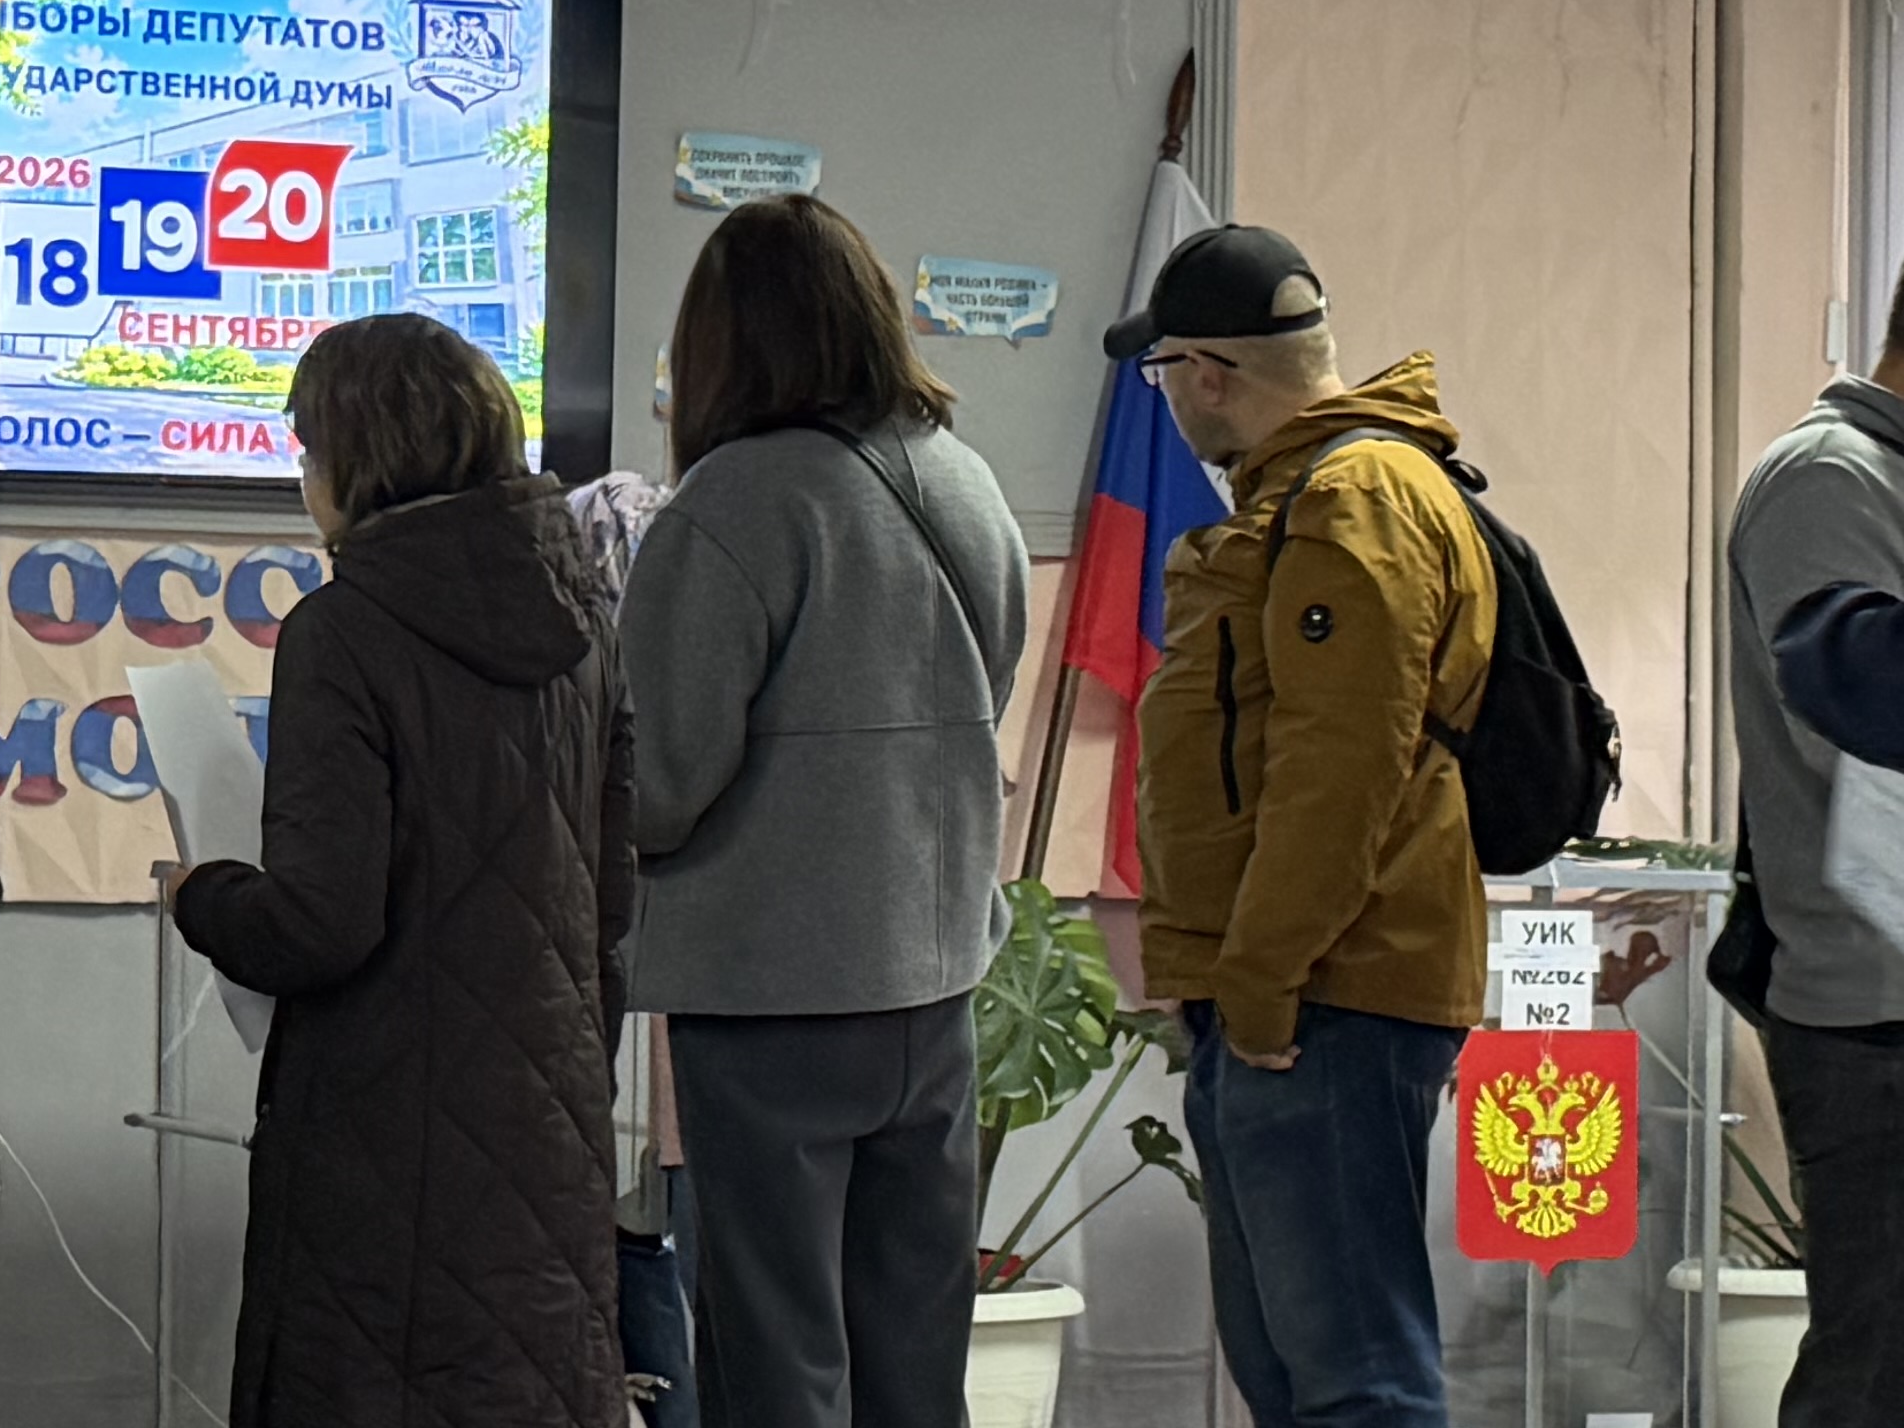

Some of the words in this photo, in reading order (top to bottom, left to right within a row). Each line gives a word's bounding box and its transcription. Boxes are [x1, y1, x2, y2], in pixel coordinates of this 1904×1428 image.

[143, 8, 385, 51] ДЕПУТАТОВ
[290, 79, 392, 110] ДУМЫ
[4, 238, 89, 307] 18
[110, 199, 198, 272] 19
[218, 168, 323, 243] 20
[160, 420, 275, 455] СИЛА
[1522, 921, 1575, 945] УИК
[1526, 1002, 1571, 1026] №2
